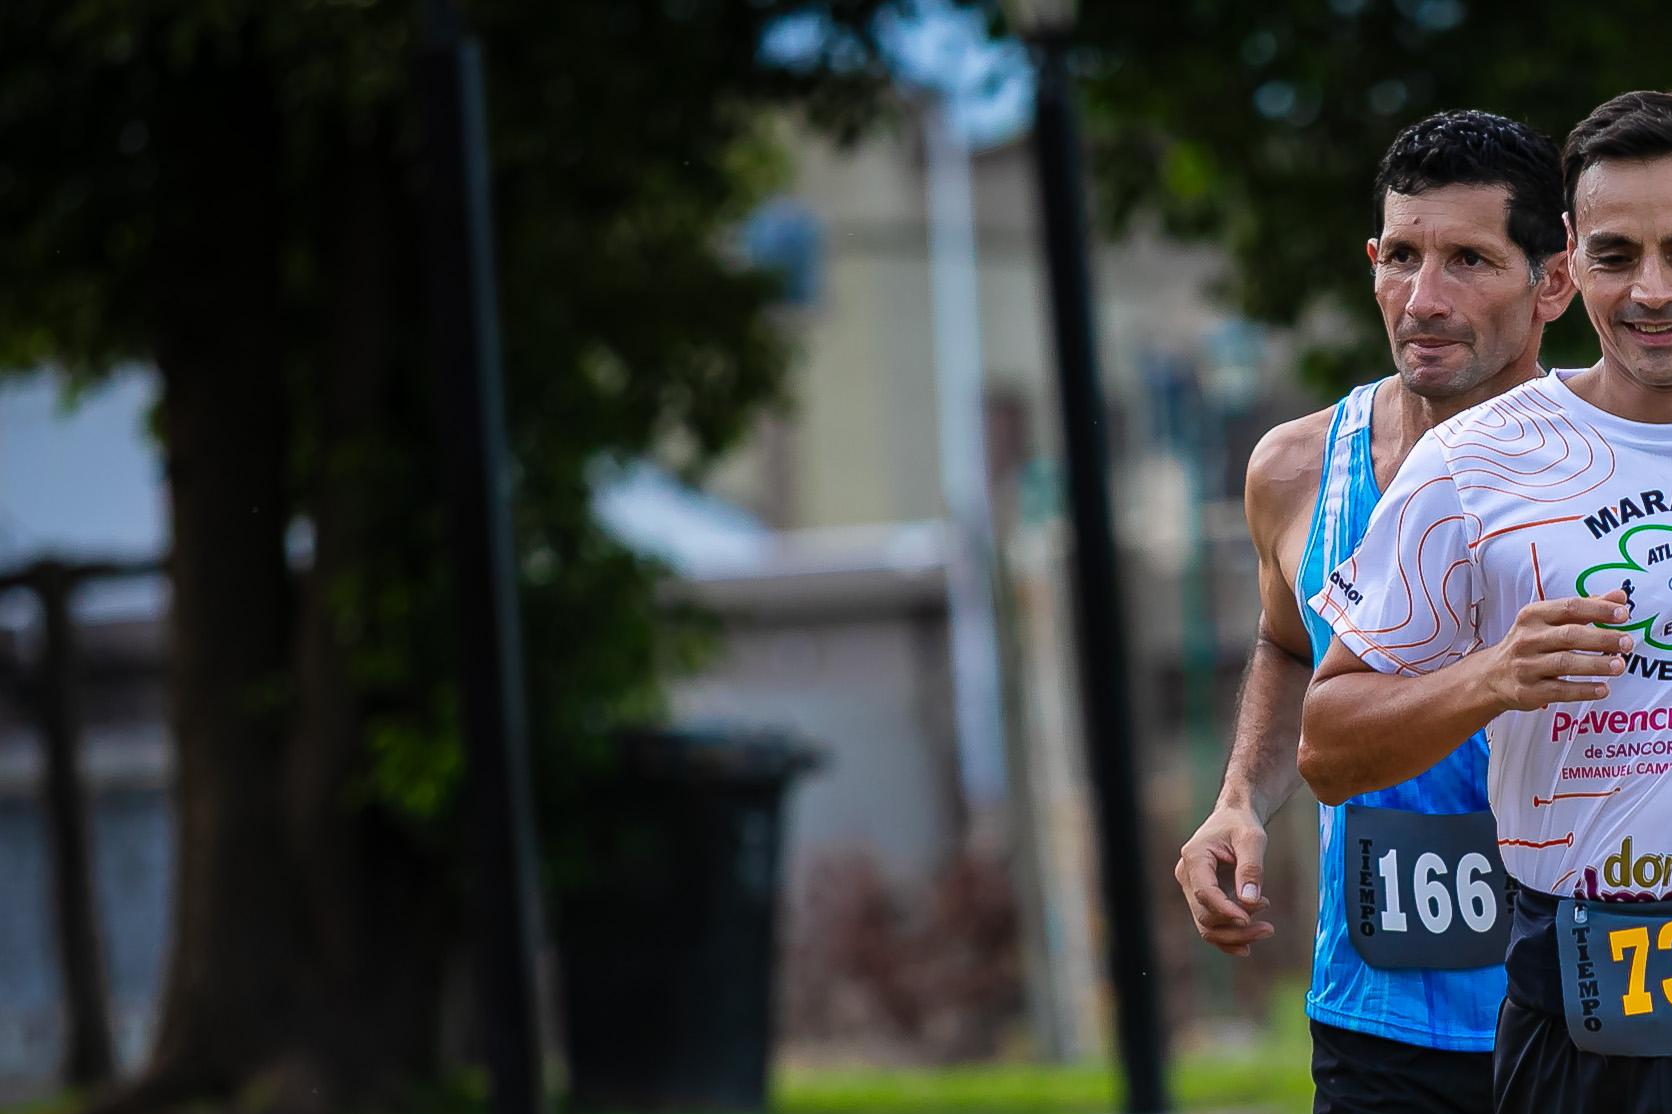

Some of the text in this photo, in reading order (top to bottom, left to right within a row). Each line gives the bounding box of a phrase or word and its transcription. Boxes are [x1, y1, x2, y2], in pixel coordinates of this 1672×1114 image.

[1561, 764, 1633, 780] EMMANUEL
[1584, 743, 1603, 759] de
[1358, 838, 1376, 937] TIEMPO
[1378, 848, 1498, 935] 166
[1571, 925, 1603, 1033] TIEMPO
